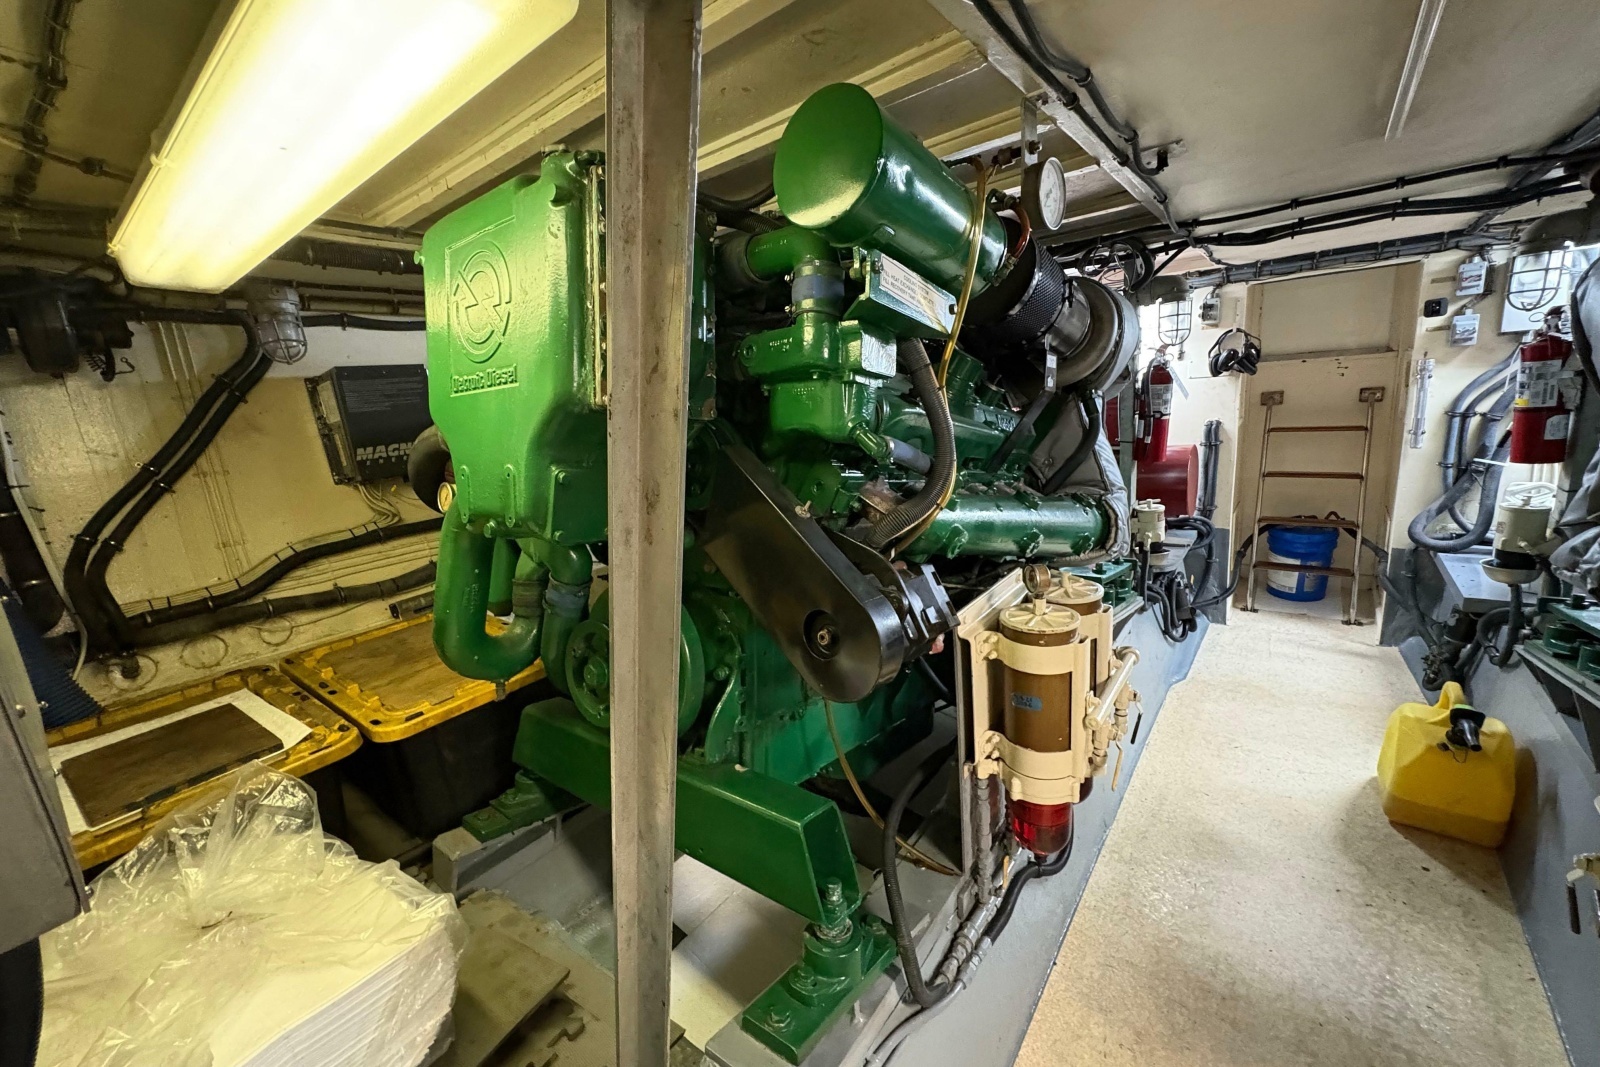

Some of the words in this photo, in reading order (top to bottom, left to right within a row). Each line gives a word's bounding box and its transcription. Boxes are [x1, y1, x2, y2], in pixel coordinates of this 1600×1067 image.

[882, 276, 890, 286] FILL
[890, 274, 900, 282] HEAT
[453, 371, 484, 393] Detroit
[486, 363, 517, 387] Diesel
[356, 442, 415, 461] MAGN
